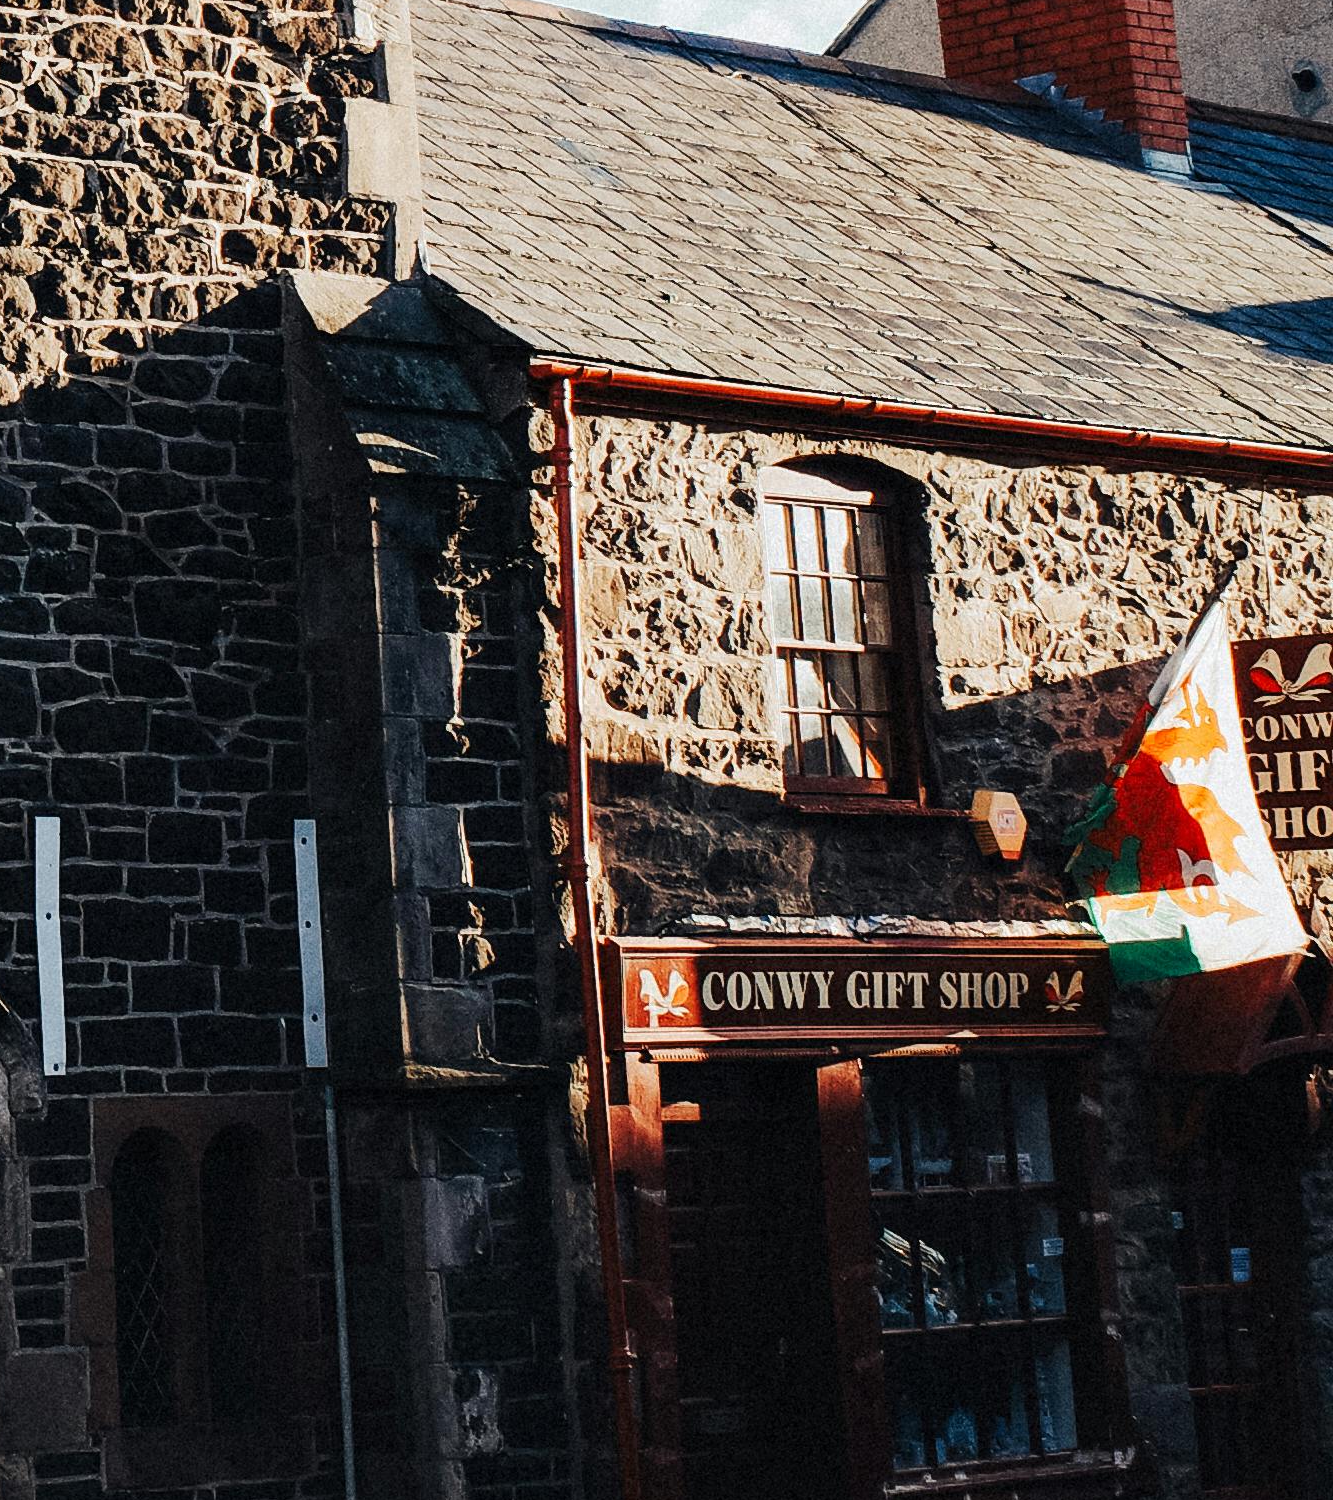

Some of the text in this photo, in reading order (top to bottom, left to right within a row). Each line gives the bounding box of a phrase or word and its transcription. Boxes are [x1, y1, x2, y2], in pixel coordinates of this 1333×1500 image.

[1247, 749, 1333, 794] GIF
[702, 970, 1029, 1011] CONWY GIFT SHOP
